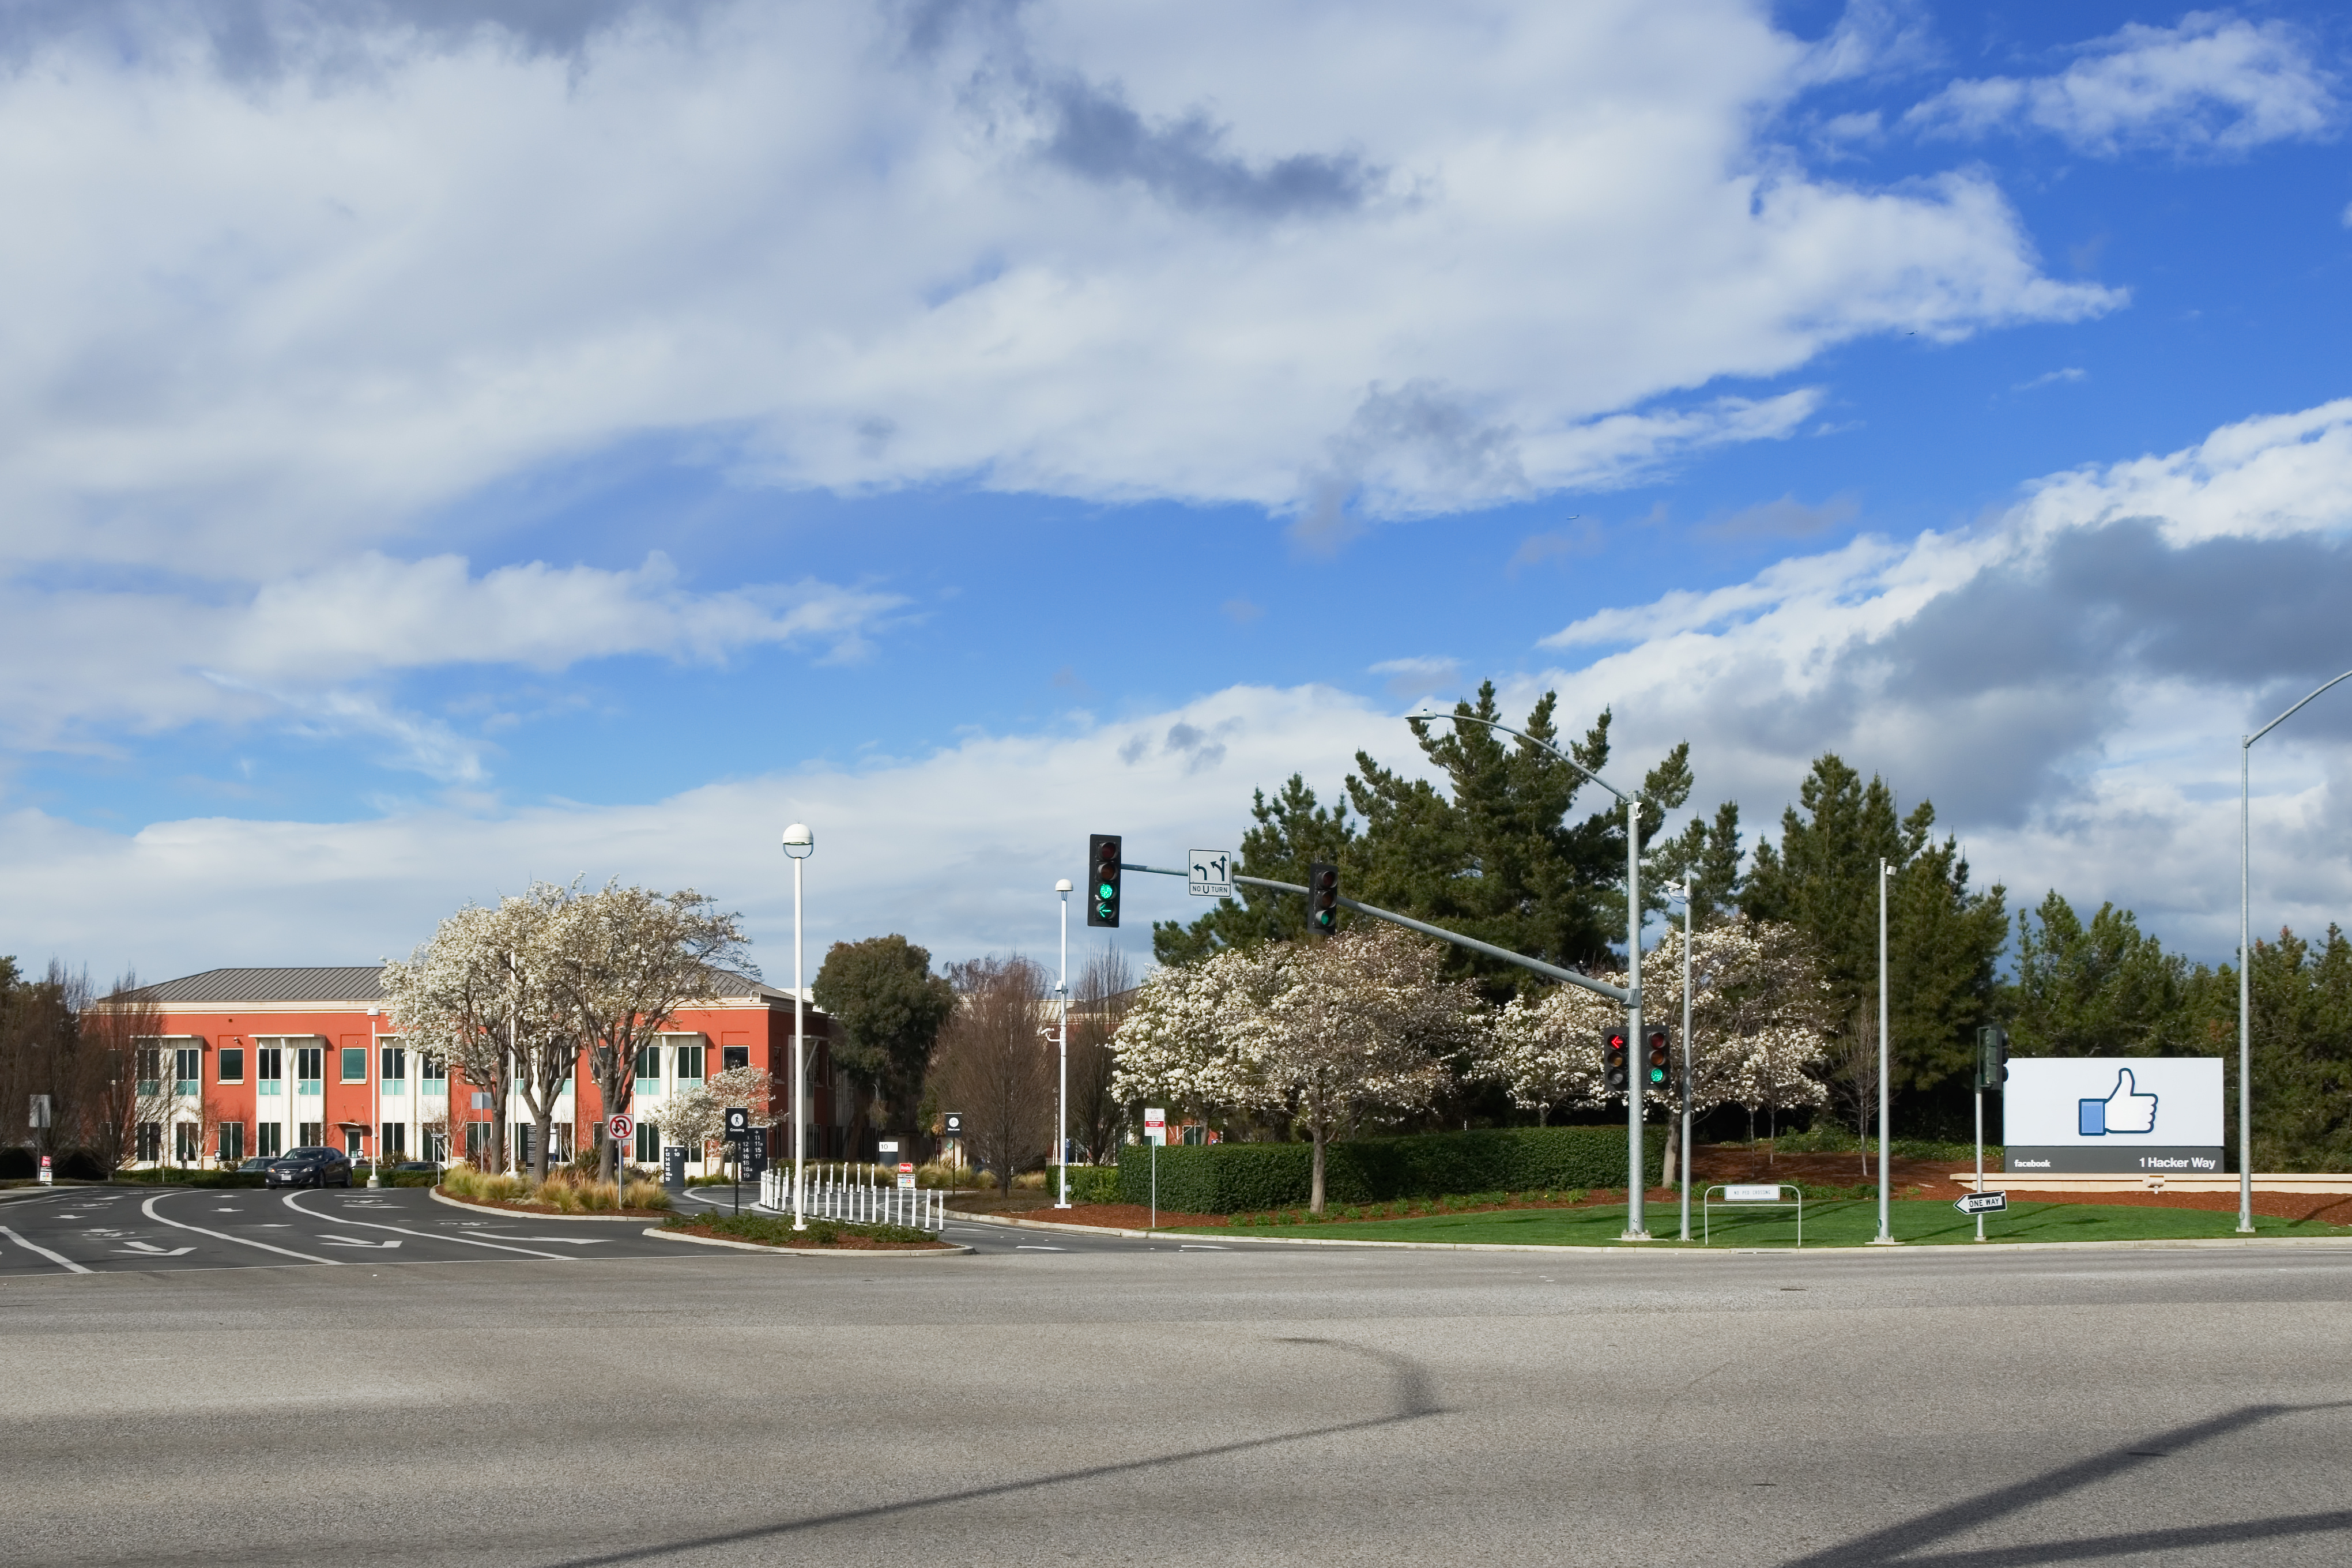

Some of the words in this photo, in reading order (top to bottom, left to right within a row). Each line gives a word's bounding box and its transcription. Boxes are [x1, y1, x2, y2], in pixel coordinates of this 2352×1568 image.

[1203, 885, 1209, 894] U
[2014, 1159, 2051, 1167] facebook
[2139, 1157, 2145, 1167] 1
[2148, 1157, 2189, 1168] Hacker
[2191, 1157, 2216, 1170] Way
[1969, 1199, 1983, 1207] ONE
[1985, 1197, 2000, 1205] WAY
